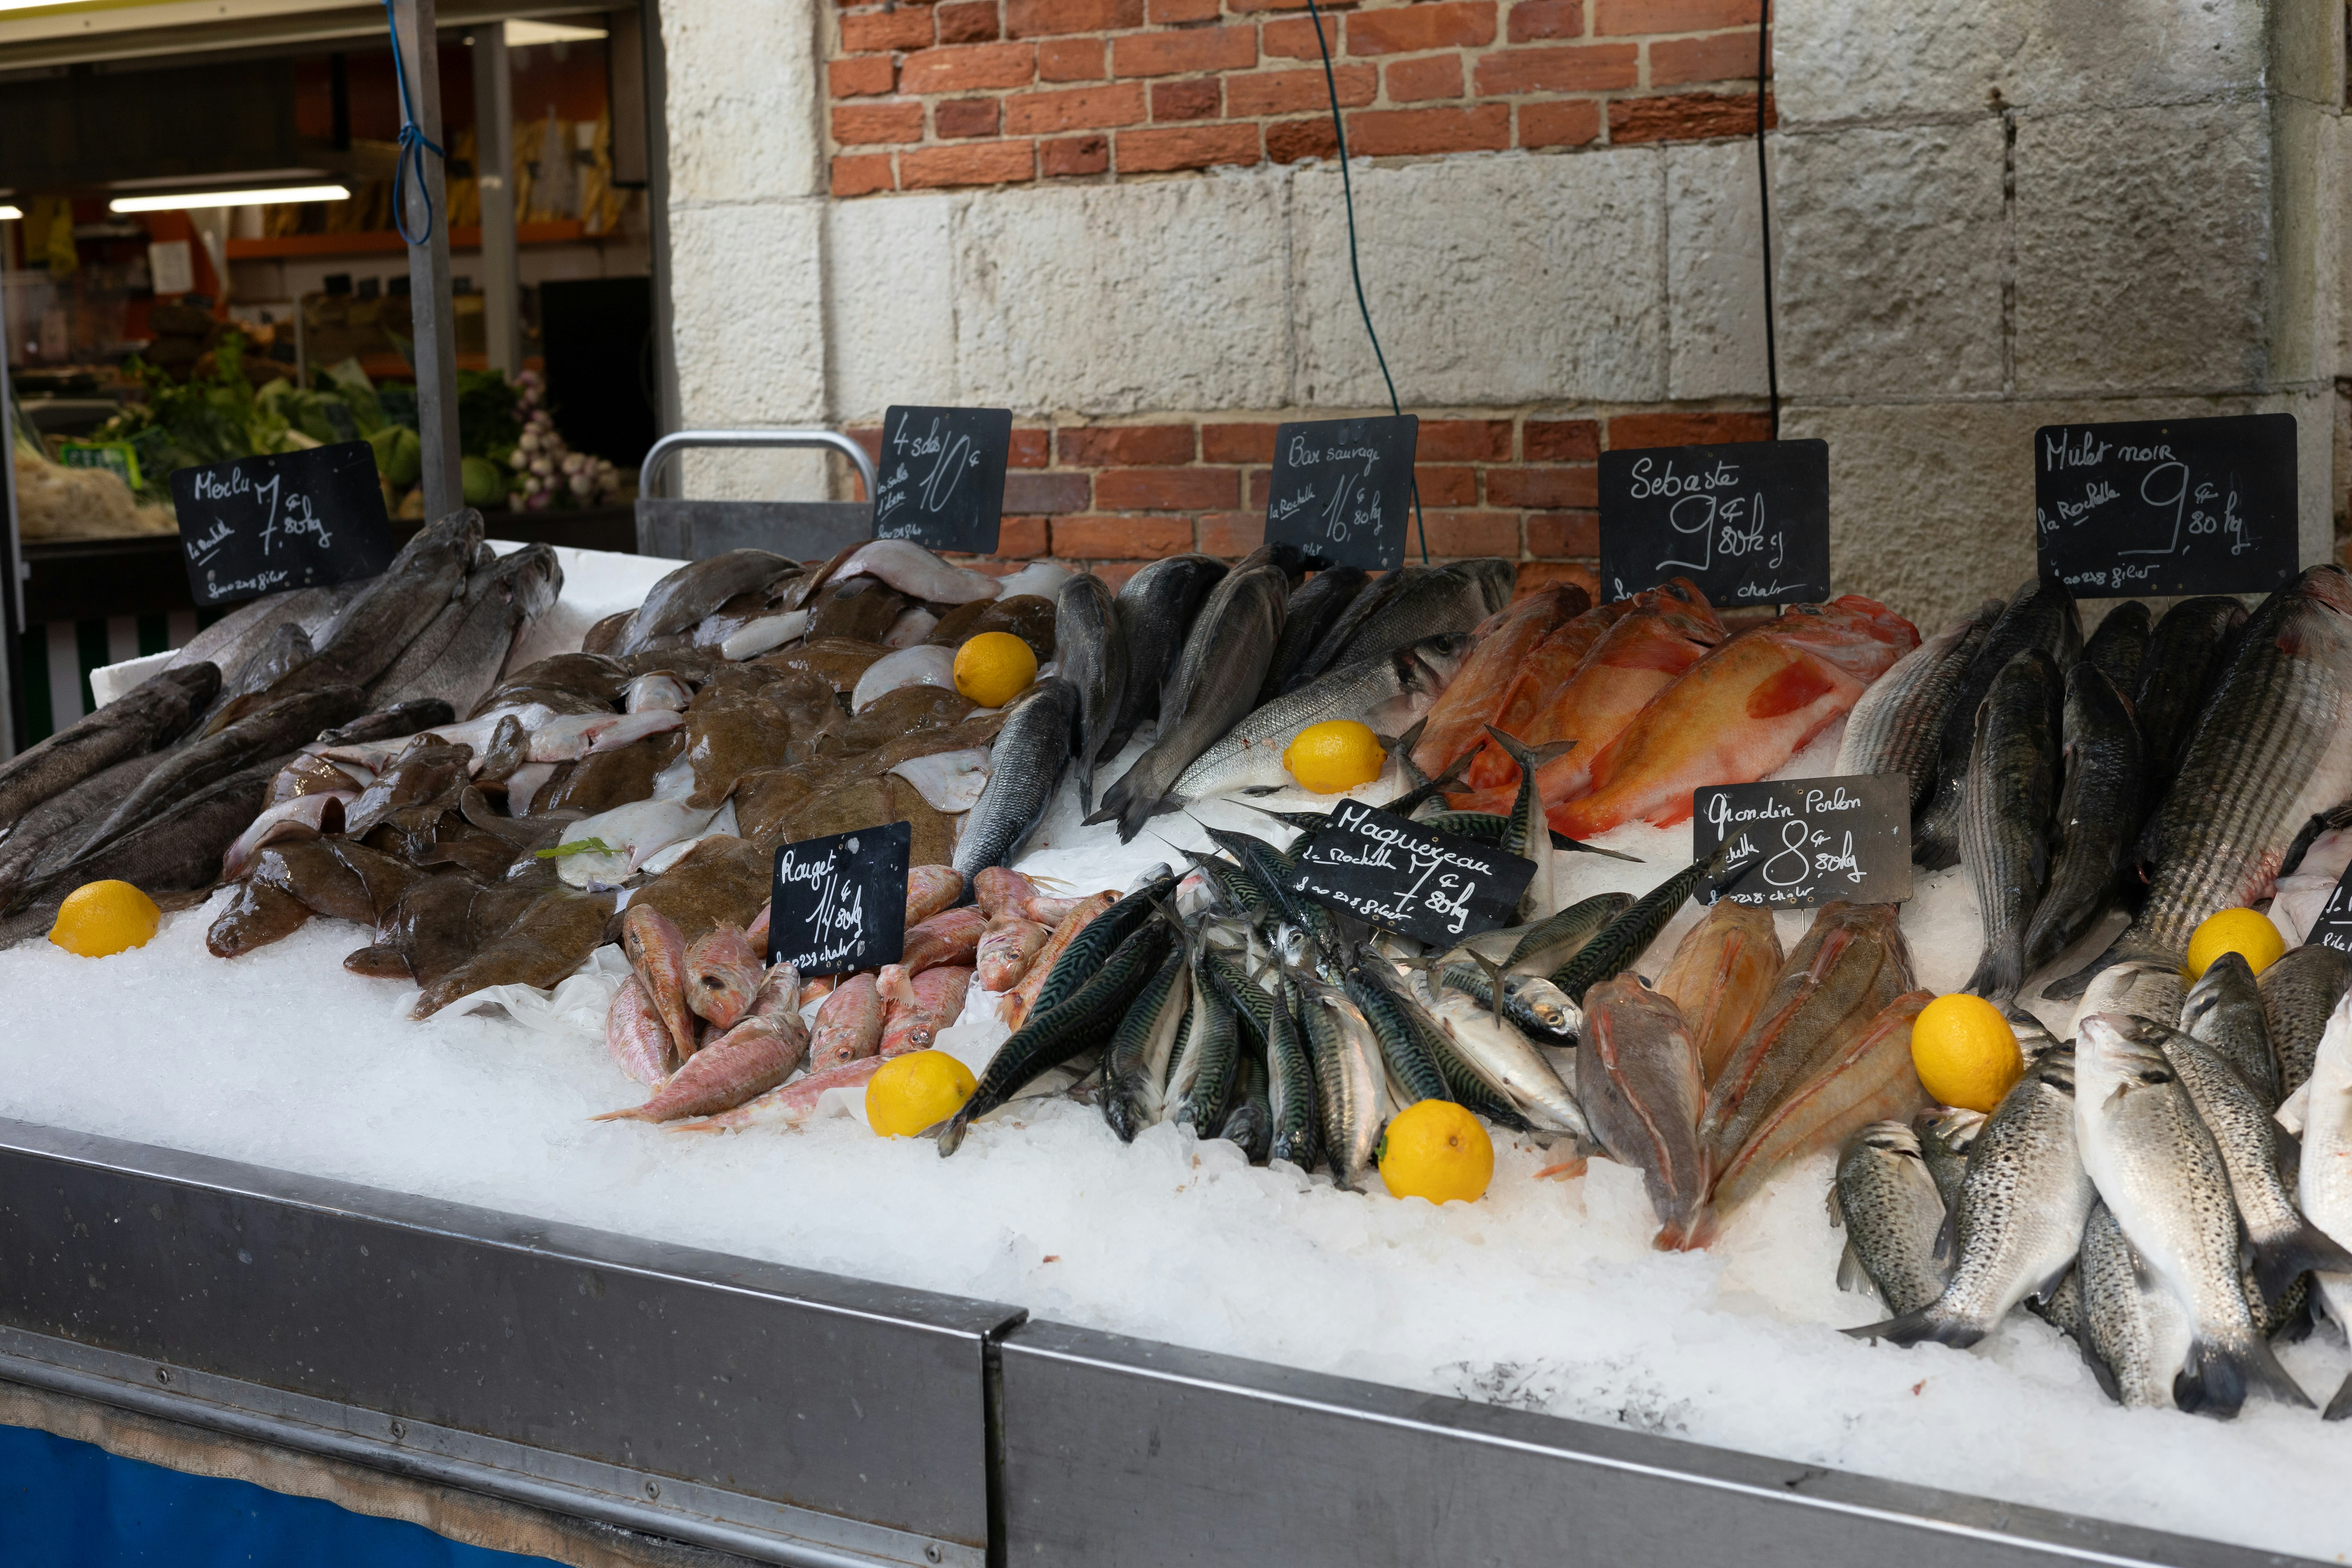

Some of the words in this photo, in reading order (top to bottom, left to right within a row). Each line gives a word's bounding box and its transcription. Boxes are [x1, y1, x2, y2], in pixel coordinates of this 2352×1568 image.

[893, 412, 909, 455] 4
[1288, 436, 1320, 467] Bar
[2046, 428, 2113, 472] Mulet
[1631, 457, 1740, 499] Sebaste
[1338, 806, 1493, 876] Maquereau
[781, 850, 837, 891] Rouget
